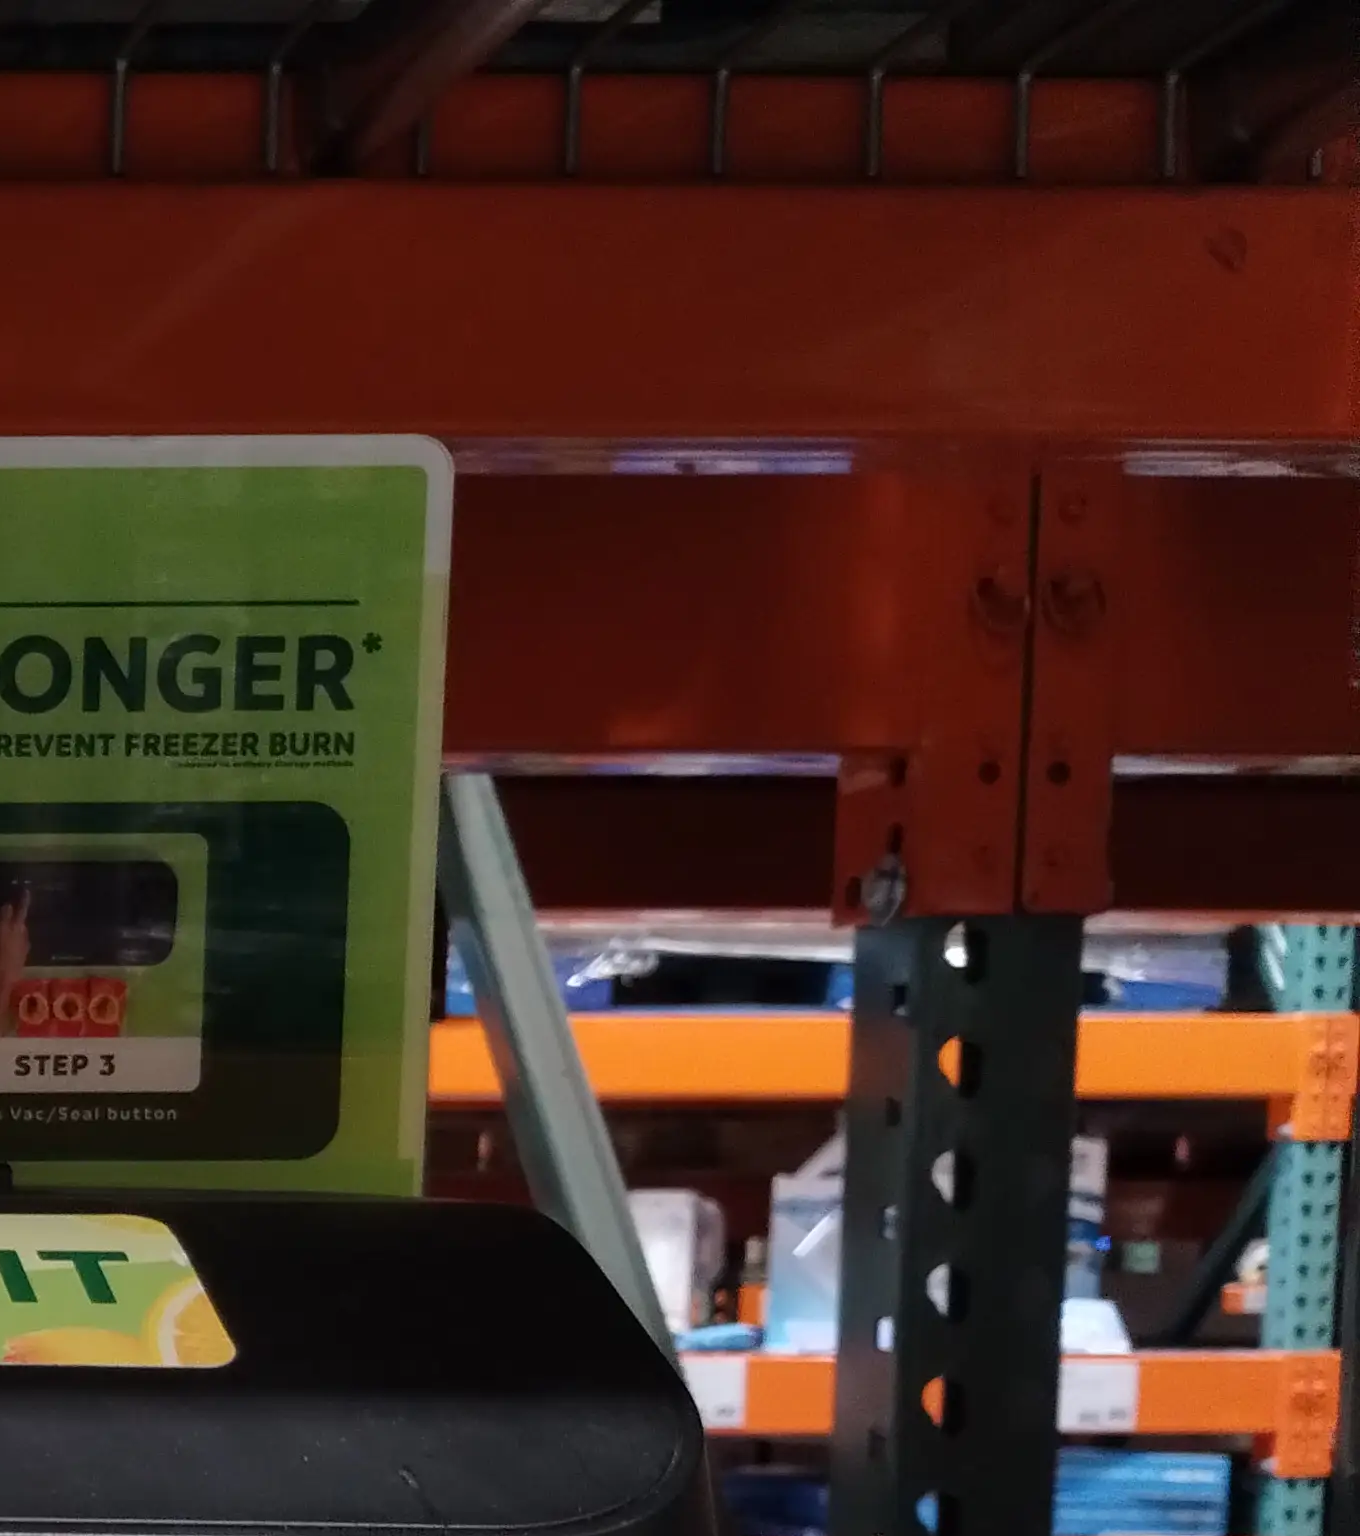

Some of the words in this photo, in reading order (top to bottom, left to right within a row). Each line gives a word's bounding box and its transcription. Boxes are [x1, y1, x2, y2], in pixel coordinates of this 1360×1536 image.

[123, 730, 260, 759] FREEZER
[267, 730, 356, 757] BURN
[13, 1053, 91, 1078] STEP
[98, 1053, 117, 1077] 3
[106, 1105, 178, 1121] button
